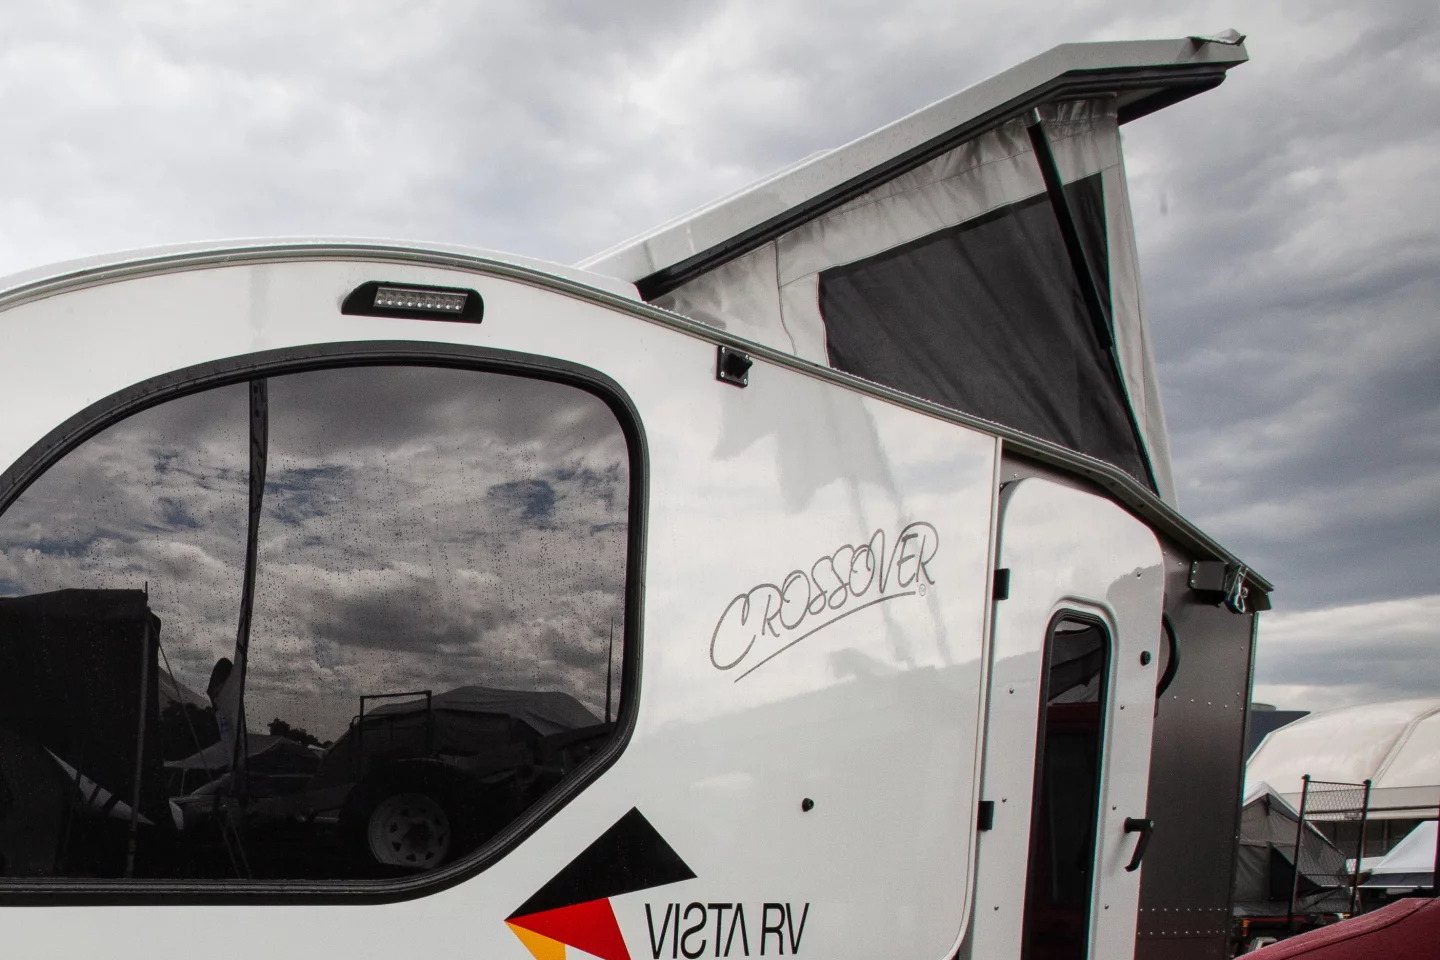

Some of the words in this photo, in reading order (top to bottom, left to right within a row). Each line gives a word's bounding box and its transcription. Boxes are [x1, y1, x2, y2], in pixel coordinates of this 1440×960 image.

[710, 521, 940, 671] CROSSOVER
[645, 901, 750, 960] VISTA
[760, 902, 811, 956] RV
